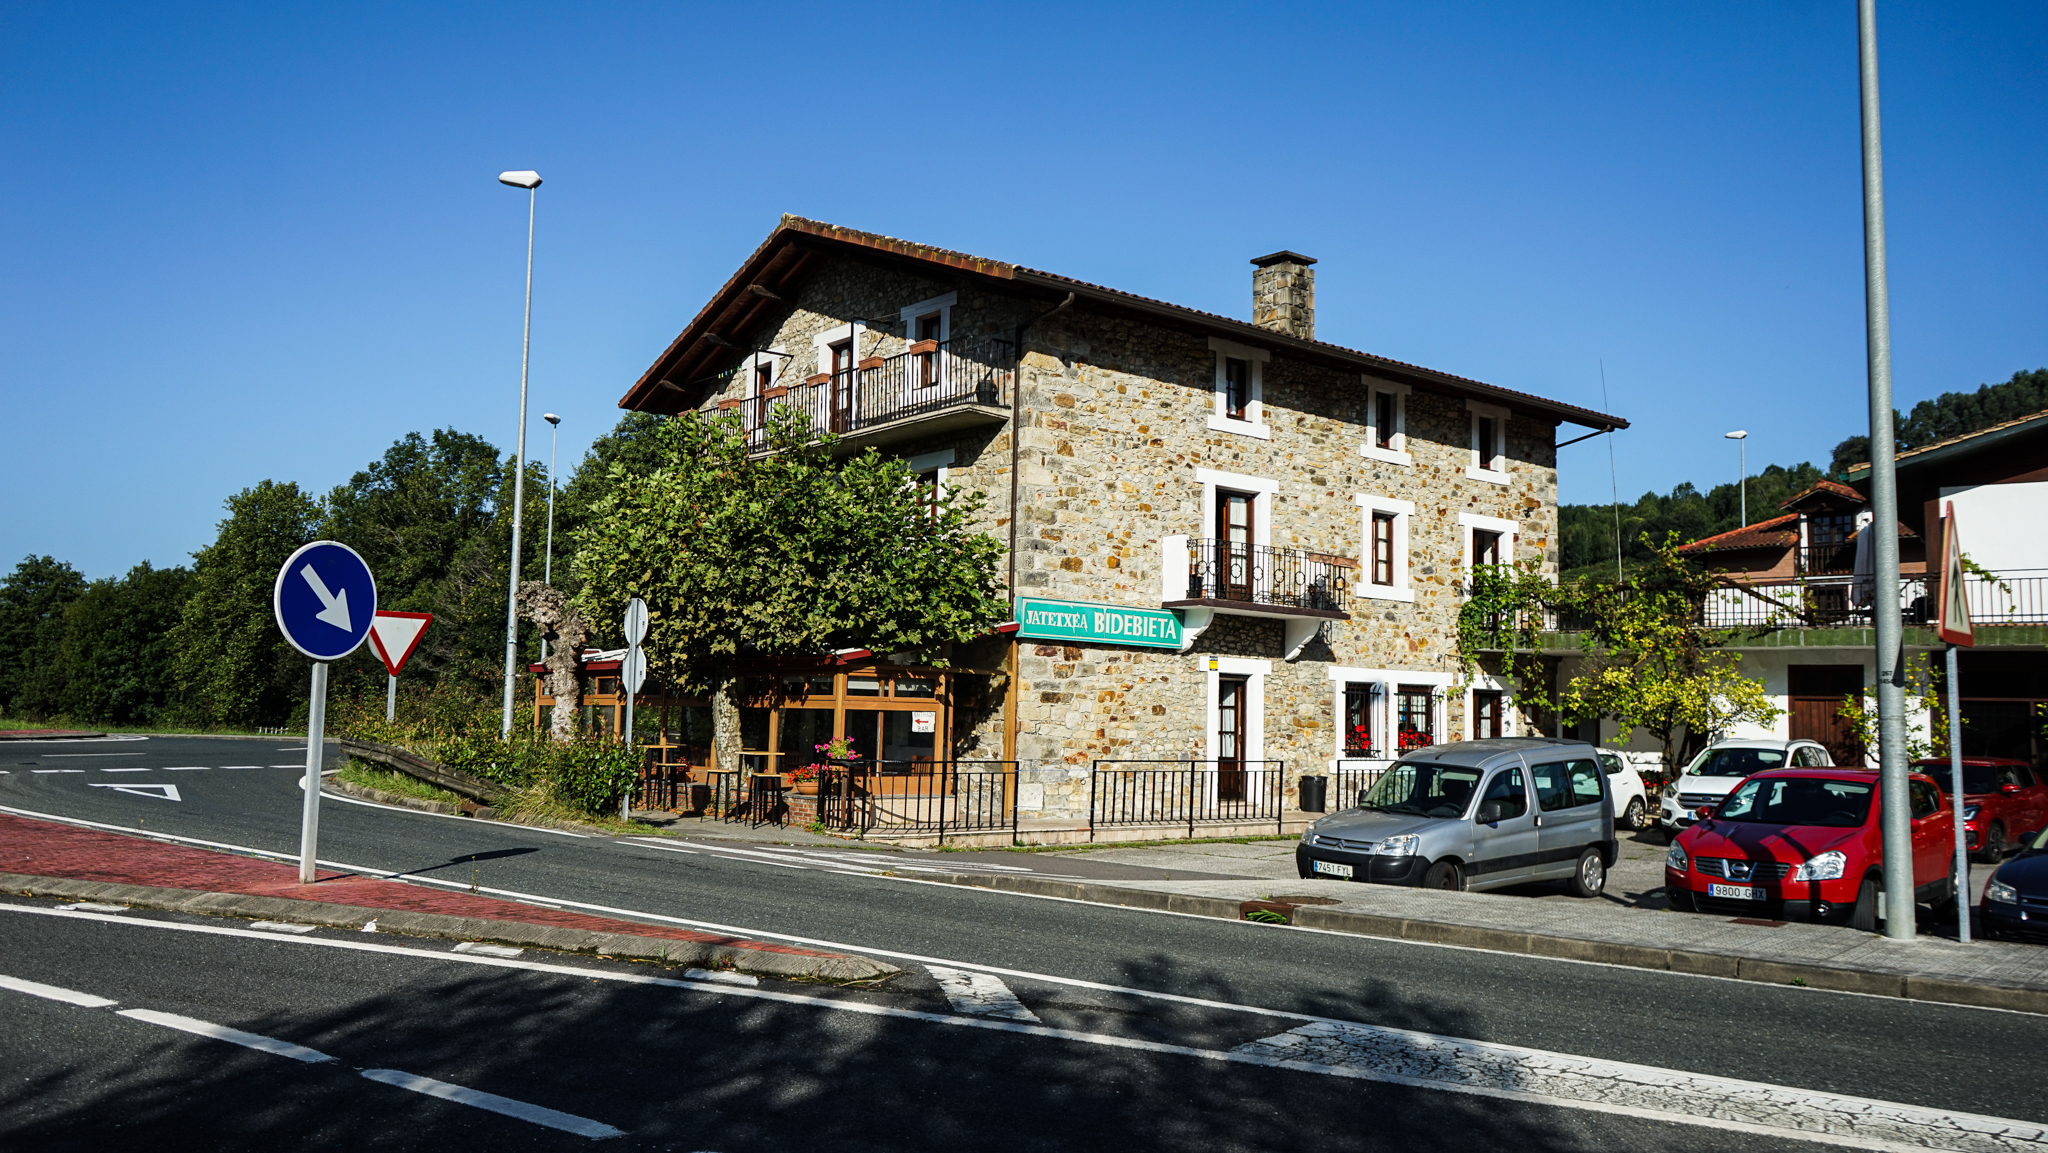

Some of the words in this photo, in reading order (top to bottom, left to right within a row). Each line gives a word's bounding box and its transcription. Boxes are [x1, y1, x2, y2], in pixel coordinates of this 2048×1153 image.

[1025, 610, 1088, 631] JATETXEA
[1094, 611, 1177, 640] BIDEBIETA
[1318, 862, 1335, 873] 7451
[1337, 865, 1351, 876] FYL
[1715, 885, 1740, 897] 9800
[1744, 888, 1765, 900] GHX
